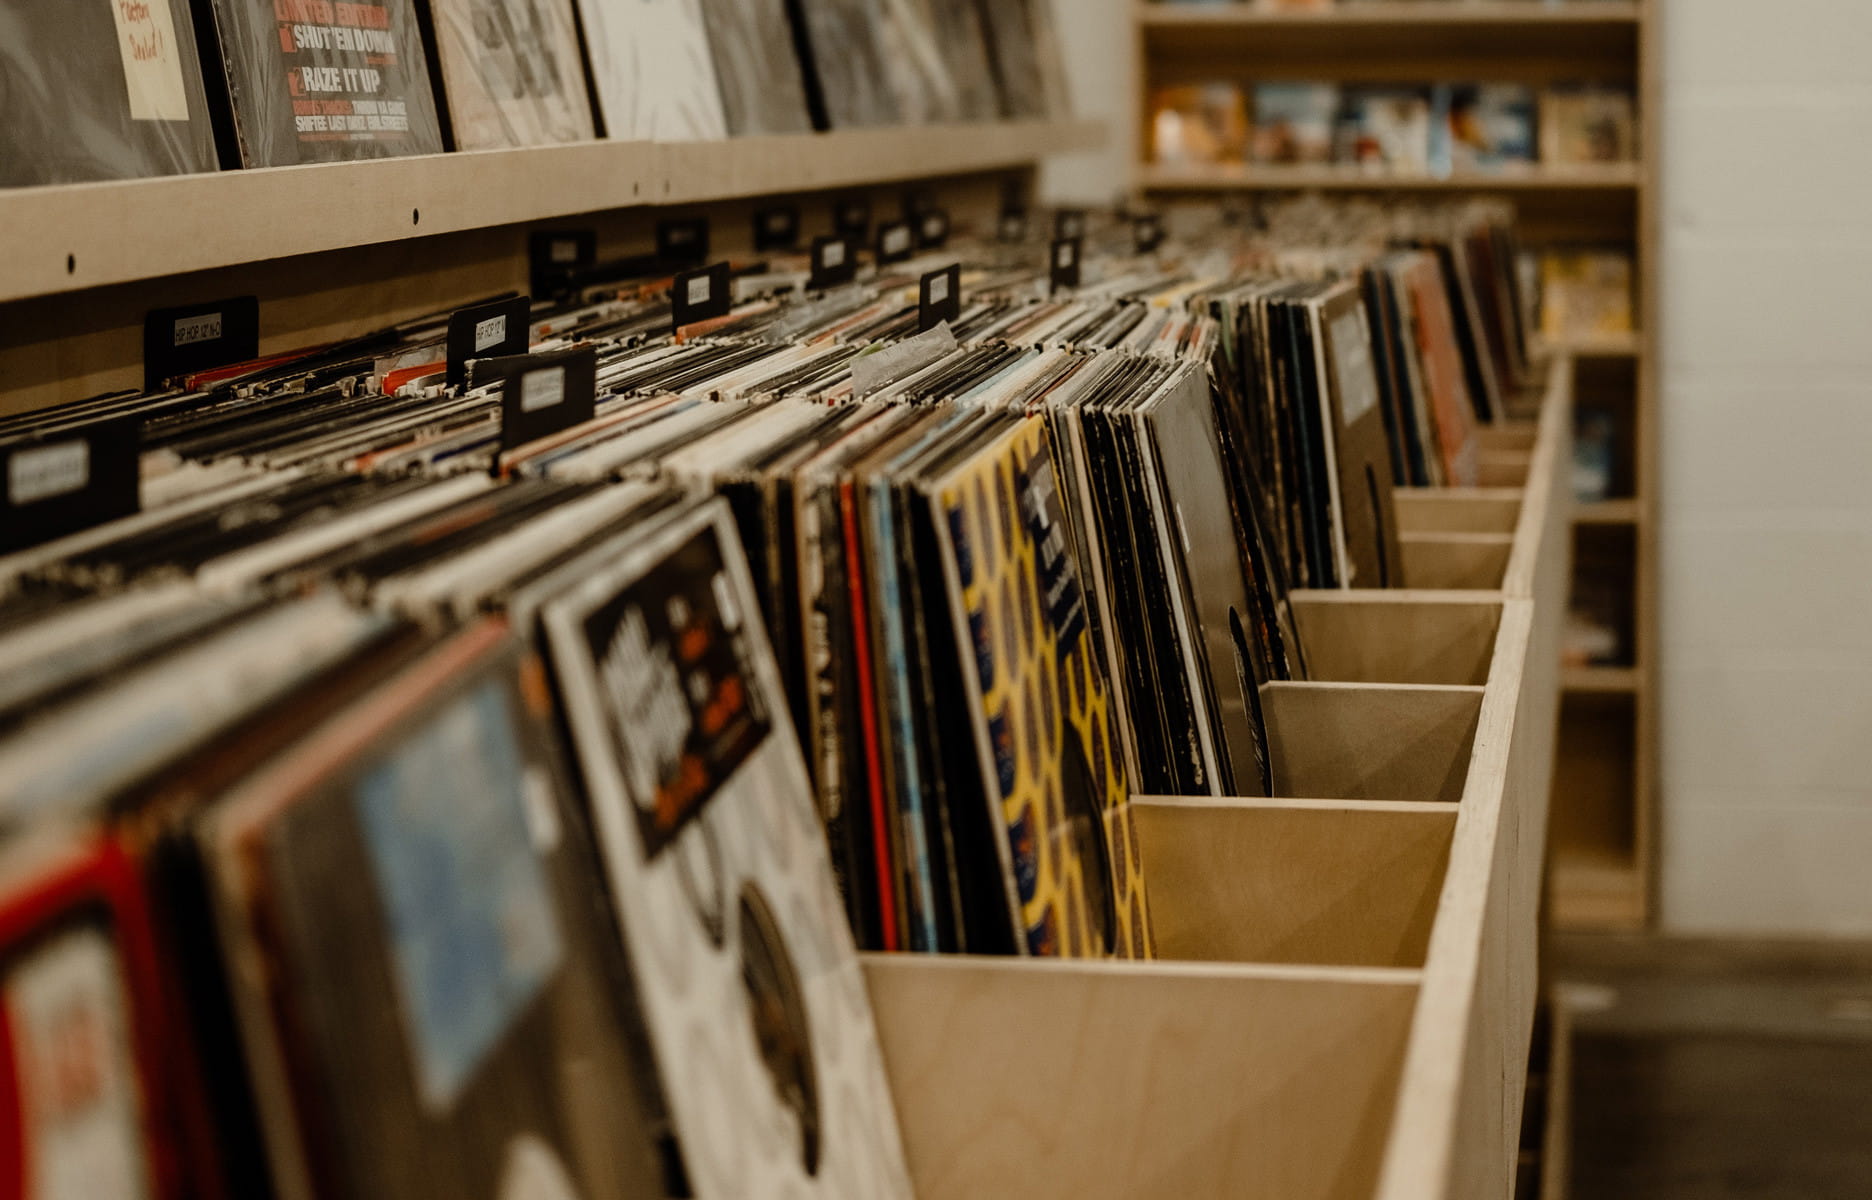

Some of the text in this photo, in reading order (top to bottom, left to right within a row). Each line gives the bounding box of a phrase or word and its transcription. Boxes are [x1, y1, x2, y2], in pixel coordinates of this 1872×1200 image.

[335, 2, 388, 28] EDITION
[293, 24, 331, 50] SHUT
[354, 28, 395, 53] DOWN
[302, 66, 343, 92] RAZE
[342, 68, 359, 92] IT
[359, 68, 381, 93] UP
[295, 115, 328, 132] SHIFTEE
